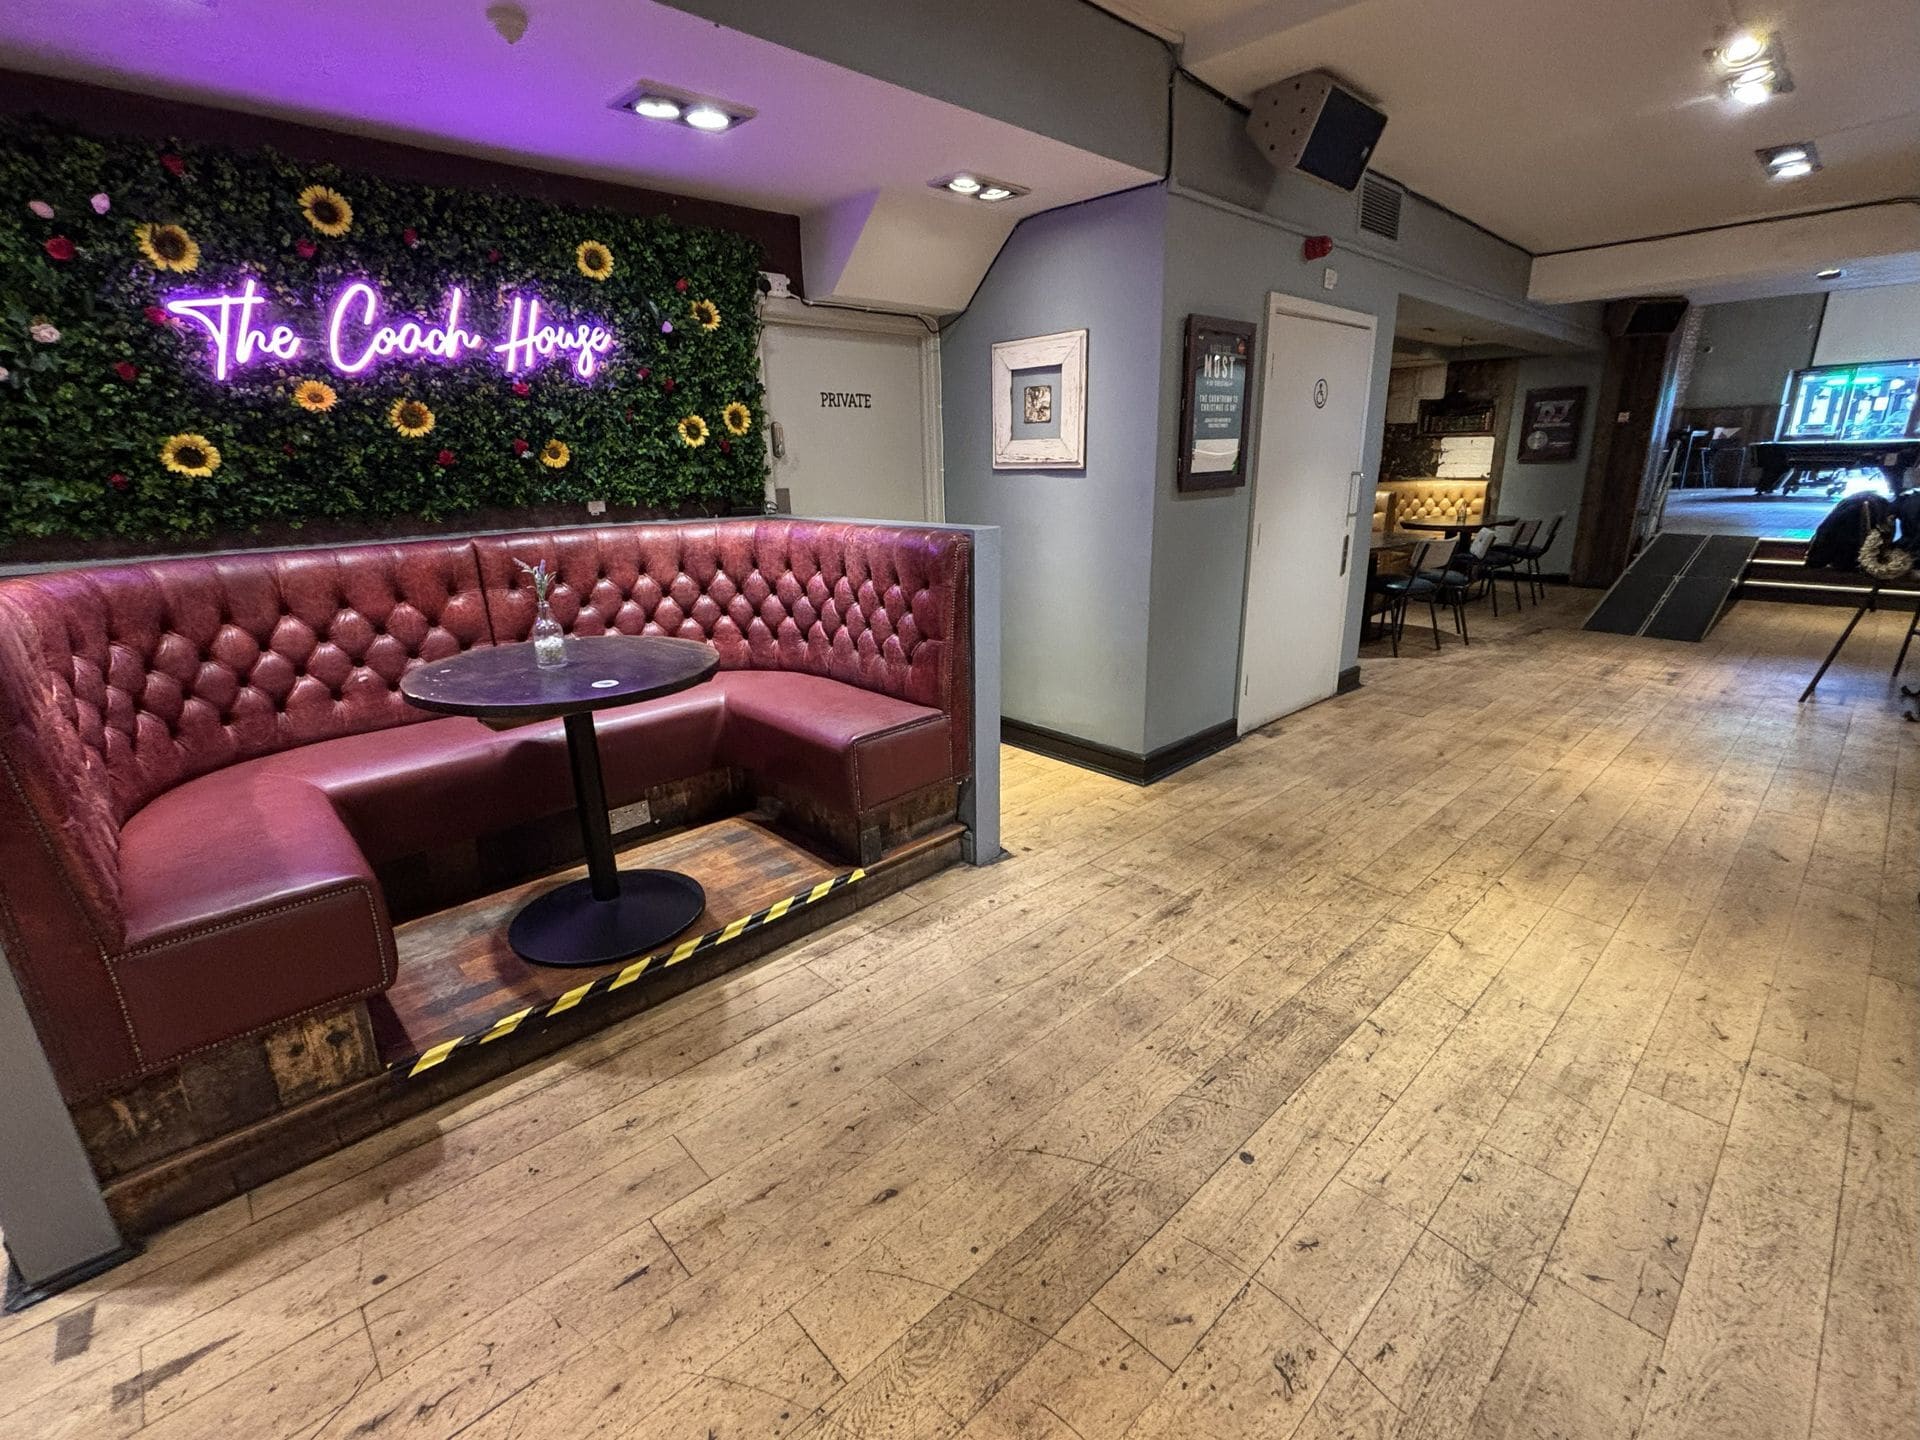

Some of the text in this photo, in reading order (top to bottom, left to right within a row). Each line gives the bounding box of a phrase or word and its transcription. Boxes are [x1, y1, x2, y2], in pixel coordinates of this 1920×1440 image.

[167, 278, 612, 382] The Coach House
[820, 391, 872, 409] PRIVATE
